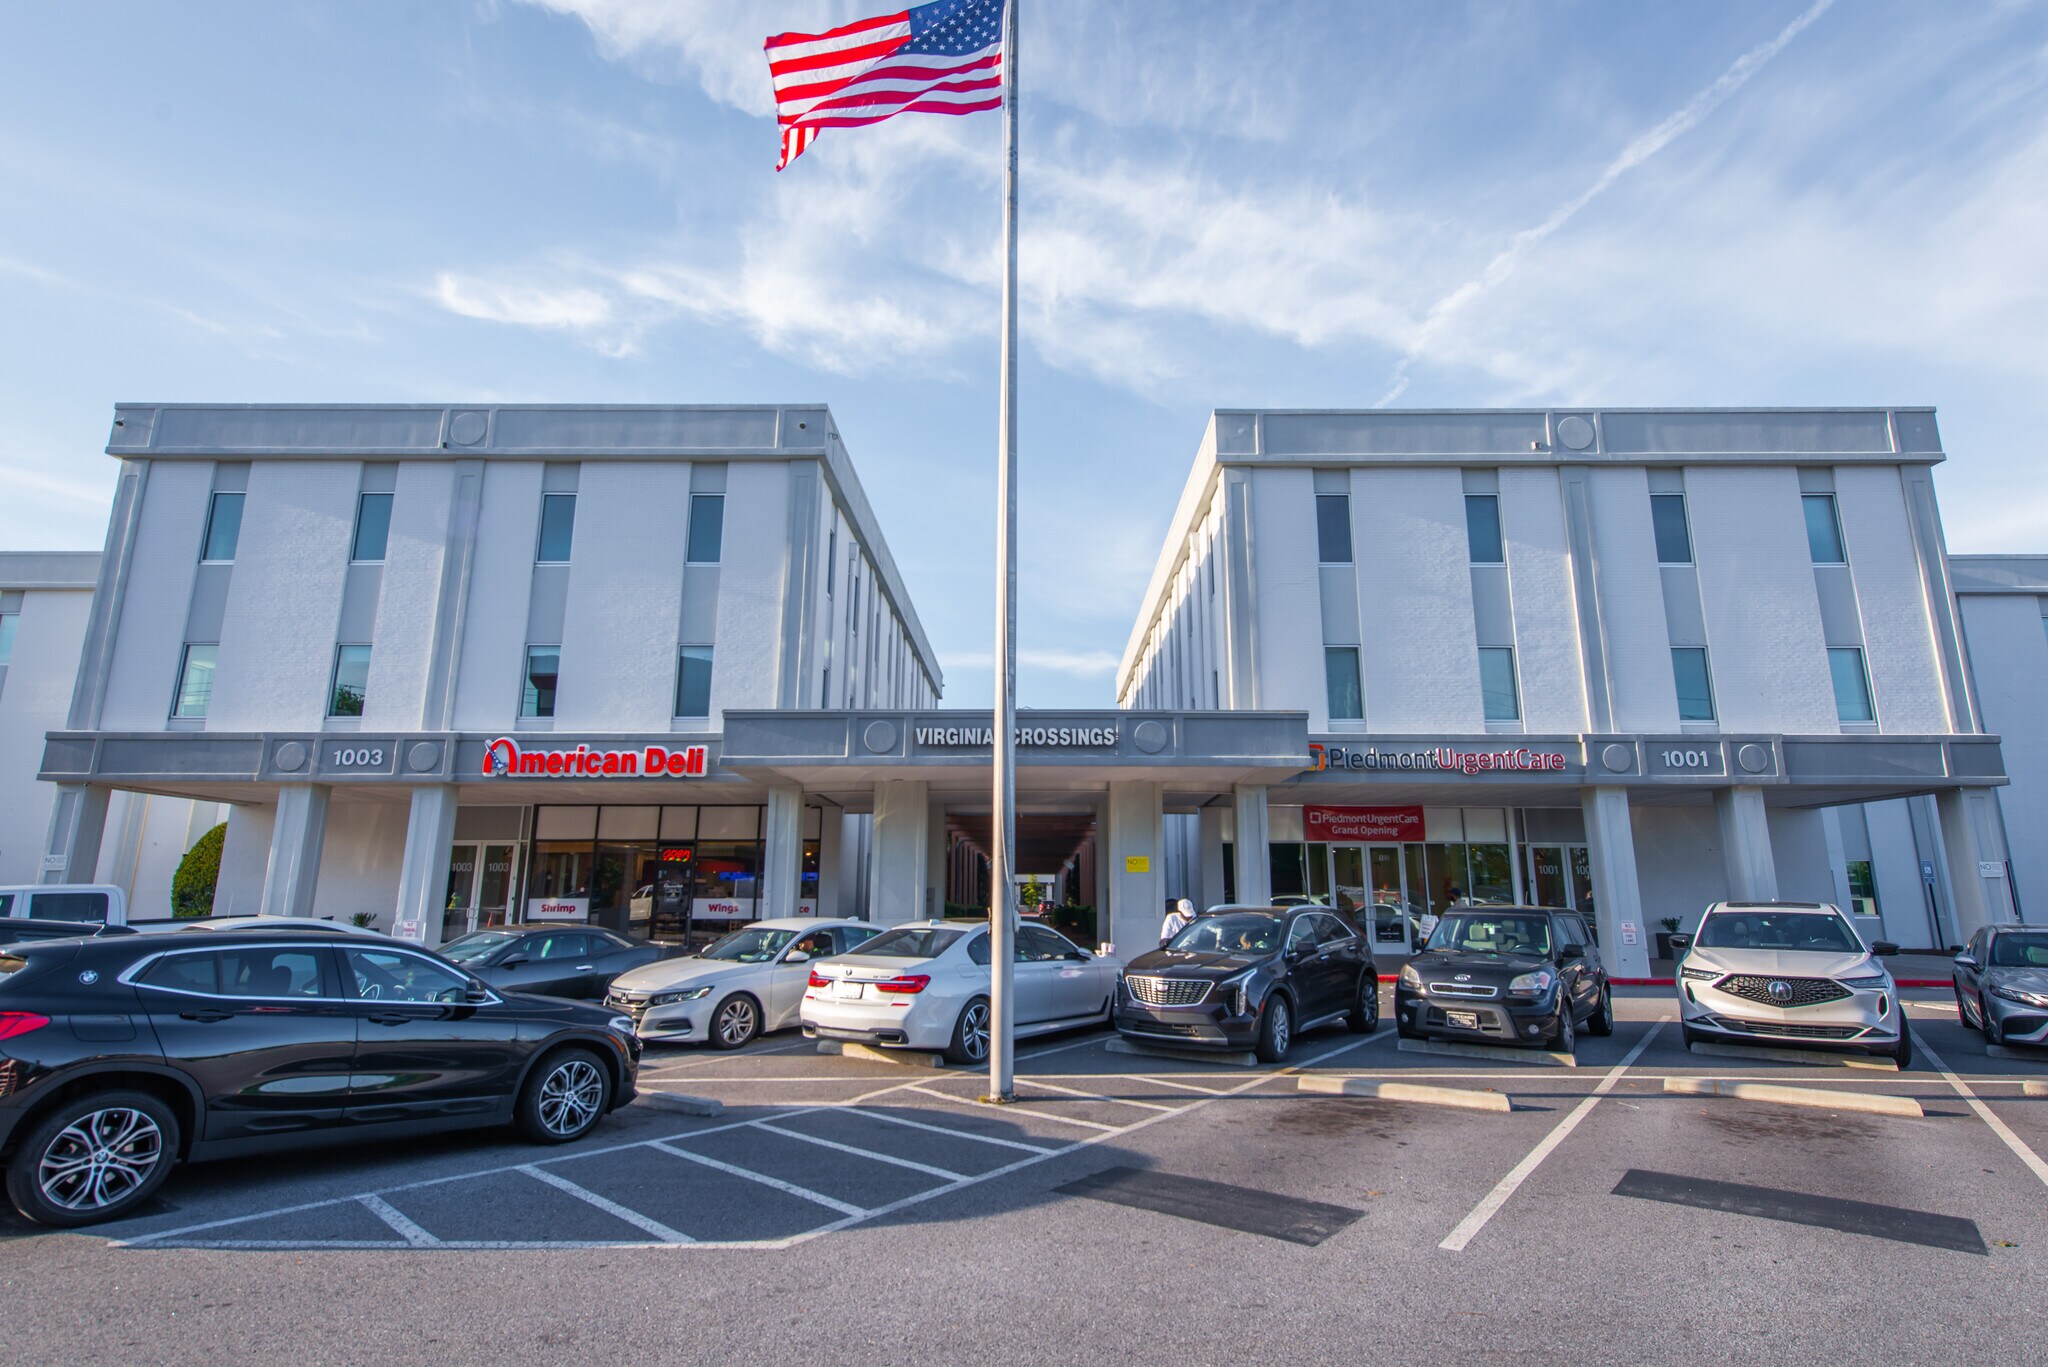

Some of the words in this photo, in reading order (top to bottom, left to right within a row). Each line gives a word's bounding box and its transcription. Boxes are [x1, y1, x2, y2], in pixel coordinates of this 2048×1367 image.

[916, 728, 994, 745] VIRGINIA
[334, 748, 383, 766] 1003
[482, 739, 637, 773] American
[644, 747, 705, 773] Deli
[1329, 748, 1566, 775] PiedmontUrgentCare
[1661, 750, 1709, 767] 1001
[1332, 825, 1359, 834] Grand
[1360, 825, 1398, 836] Opening
[452, 862, 473, 872] 1003
[488, 862, 509, 872] 1003
[1127, 858, 1138, 866] NO
[1538, 865, 1559, 875] 1001
[1576, 865, 1590, 875] 100
[541, 903, 576, 914] Shrimp
[708, 904, 739, 914] Wings
